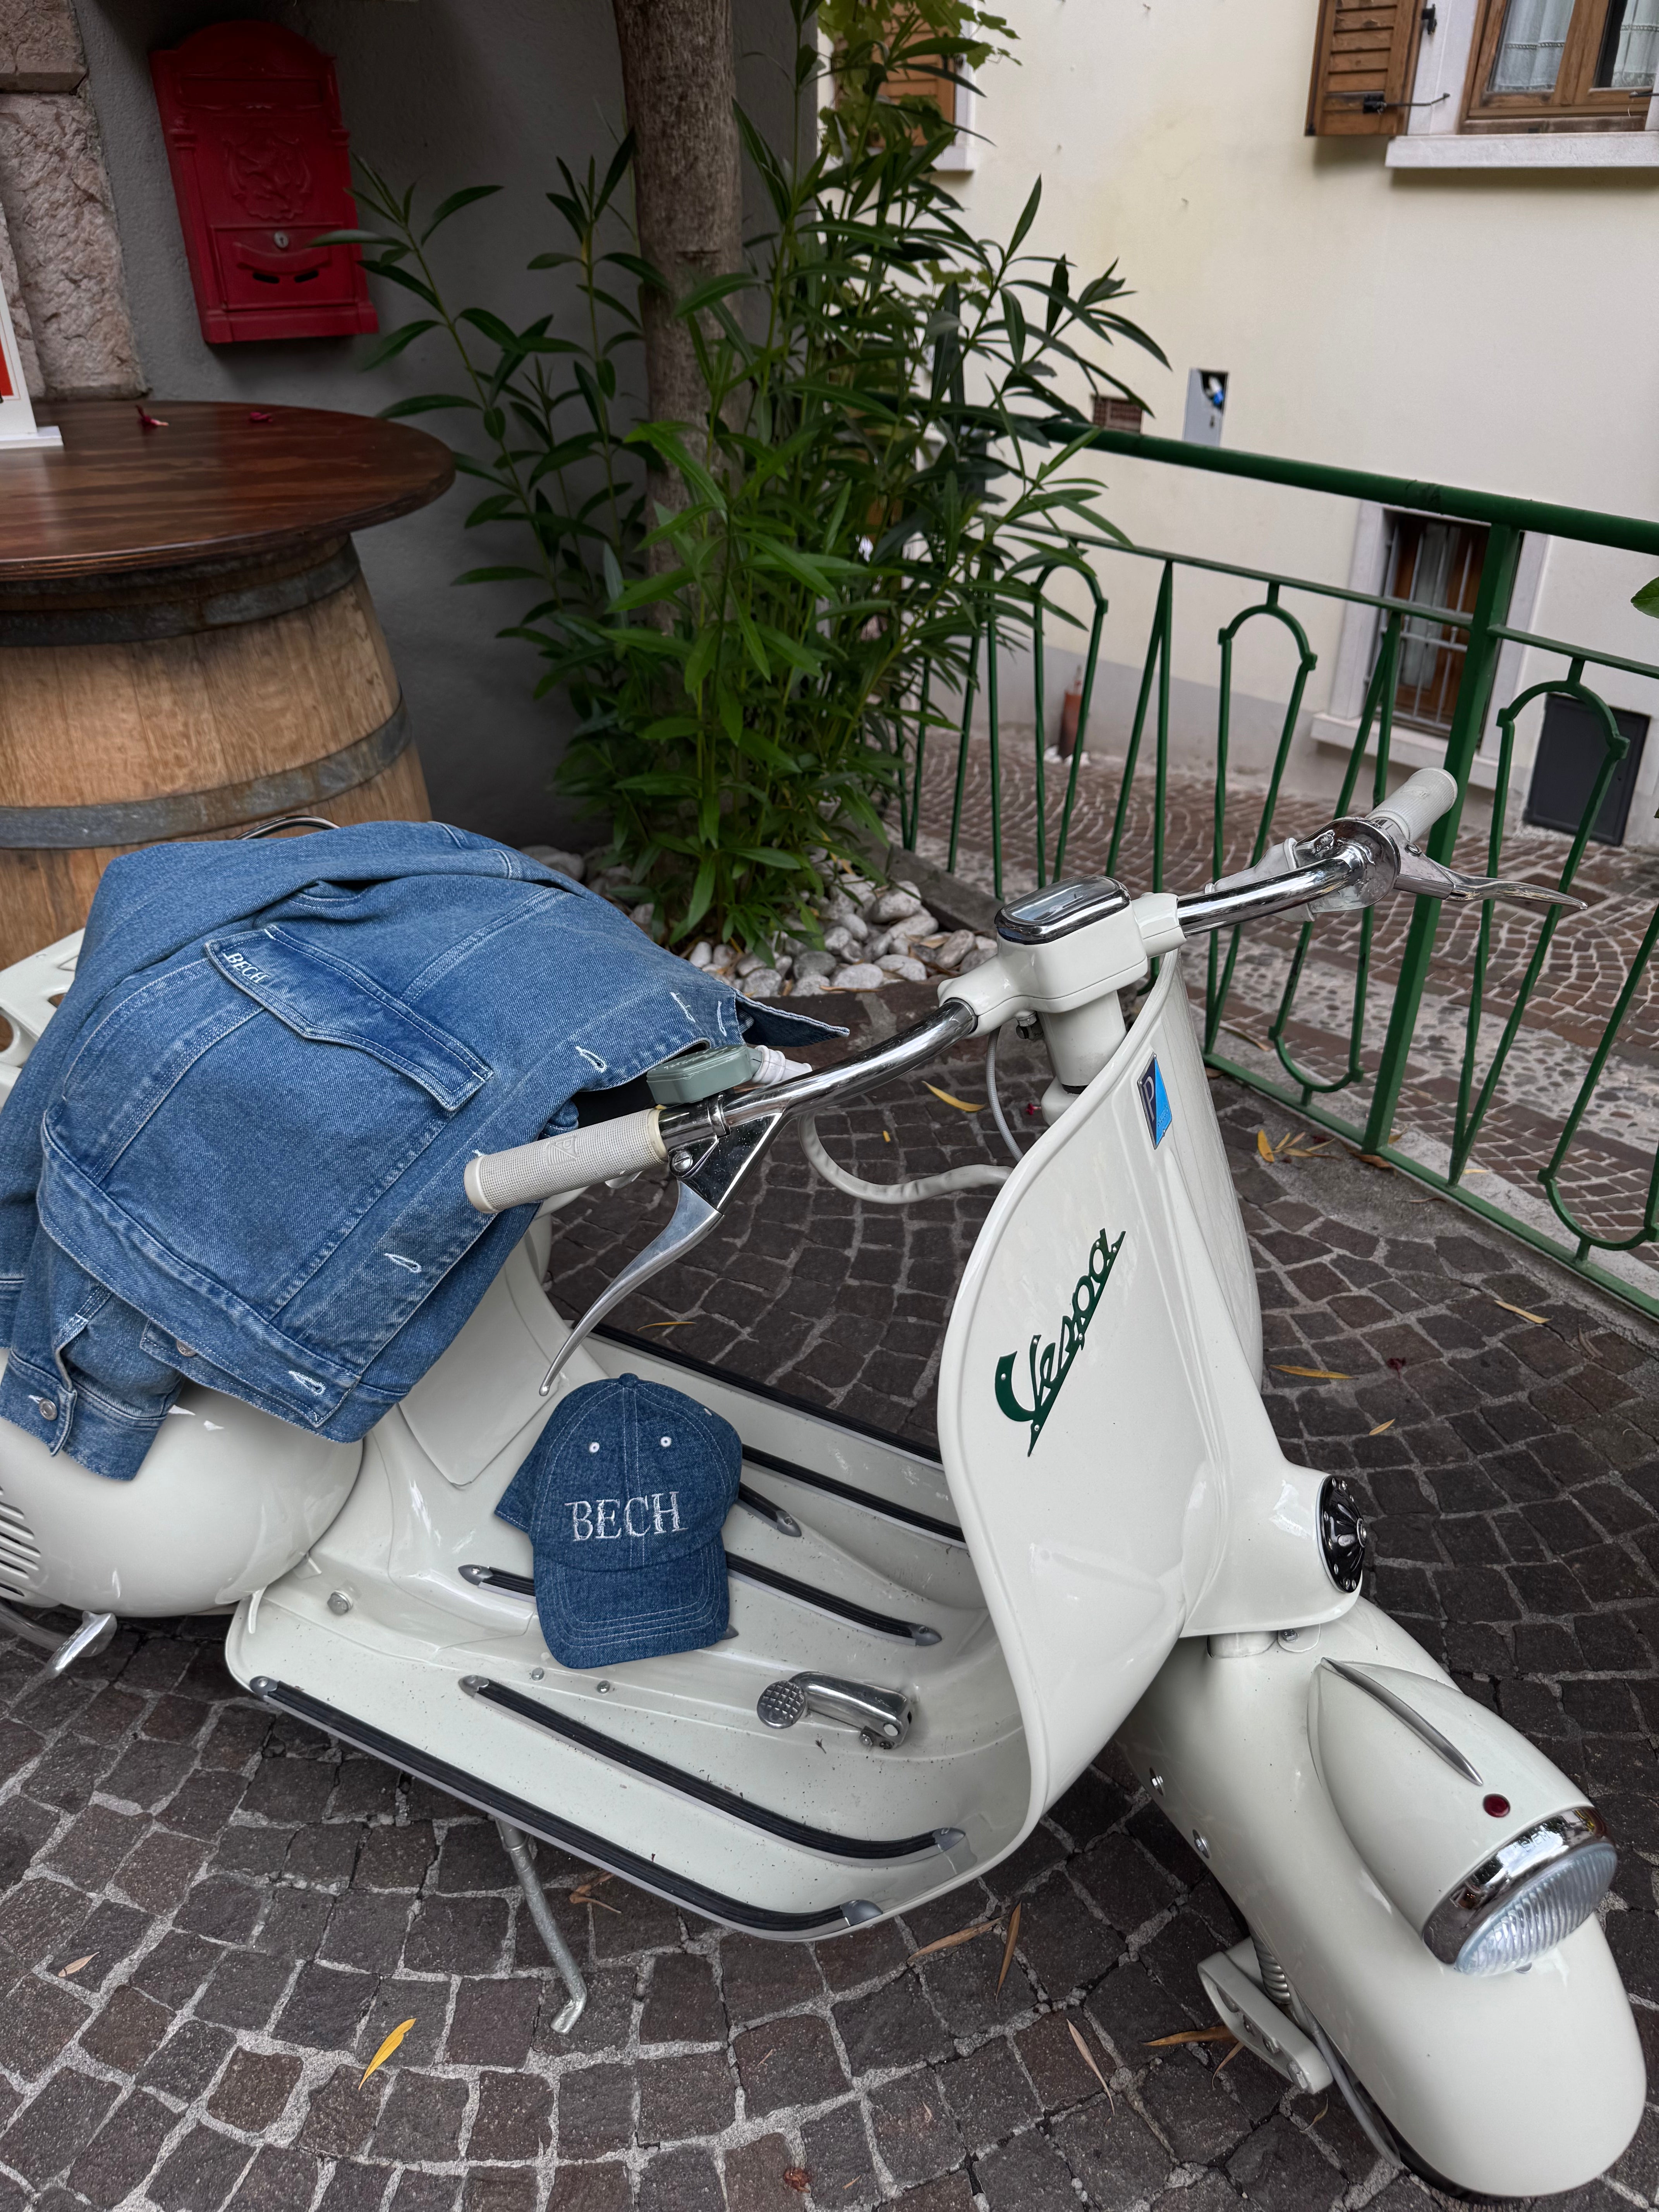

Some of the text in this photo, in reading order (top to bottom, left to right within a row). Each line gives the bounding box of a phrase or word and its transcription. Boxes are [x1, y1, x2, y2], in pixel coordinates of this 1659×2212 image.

[221, 951, 271, 984] BECH
[994, 1227, 1126, 1457] Vespa
[564, 1491, 689, 1542] BECH
[1521, 1829, 1551, 1852] SIEM
